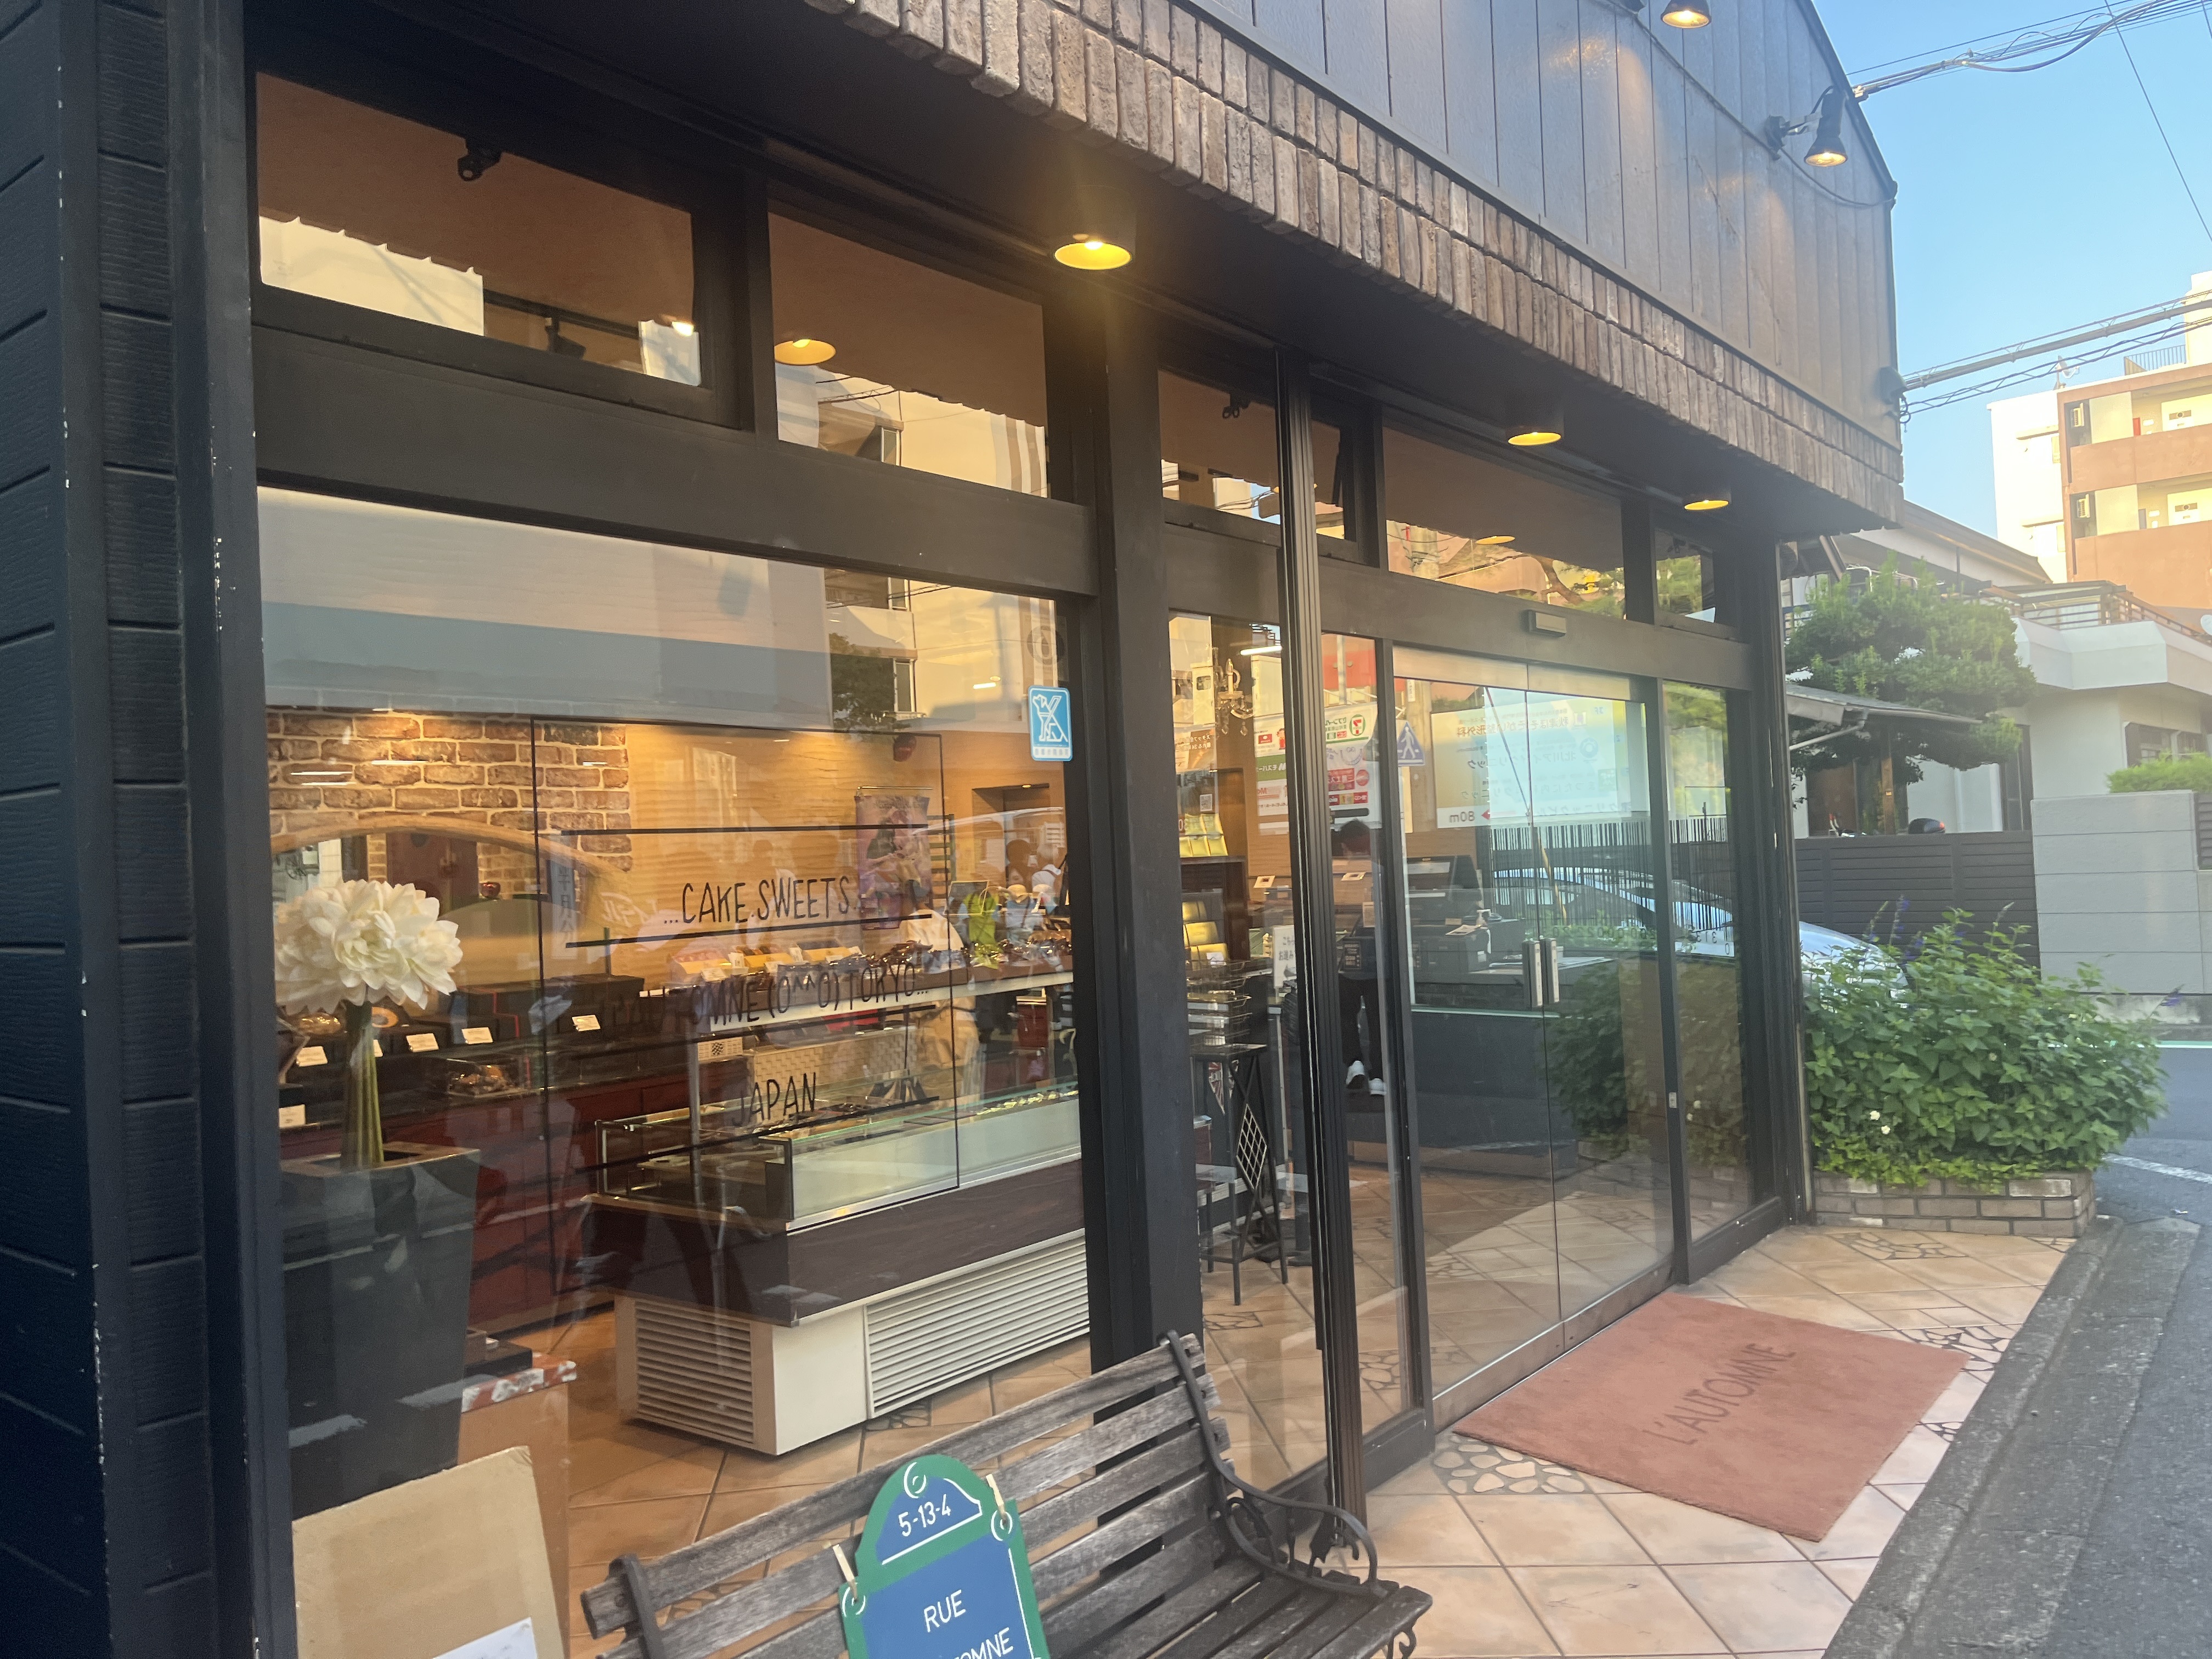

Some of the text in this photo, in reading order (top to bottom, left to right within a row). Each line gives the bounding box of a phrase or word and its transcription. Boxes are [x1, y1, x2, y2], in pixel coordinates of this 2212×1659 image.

[732, 1073, 817, 1126] JAPAN
[1642, 1342, 1797, 1446] L'AUTOMNE
[898, 1493, 951, 1537] 5-13-4
[923, 1589, 967, 1633] RUE
